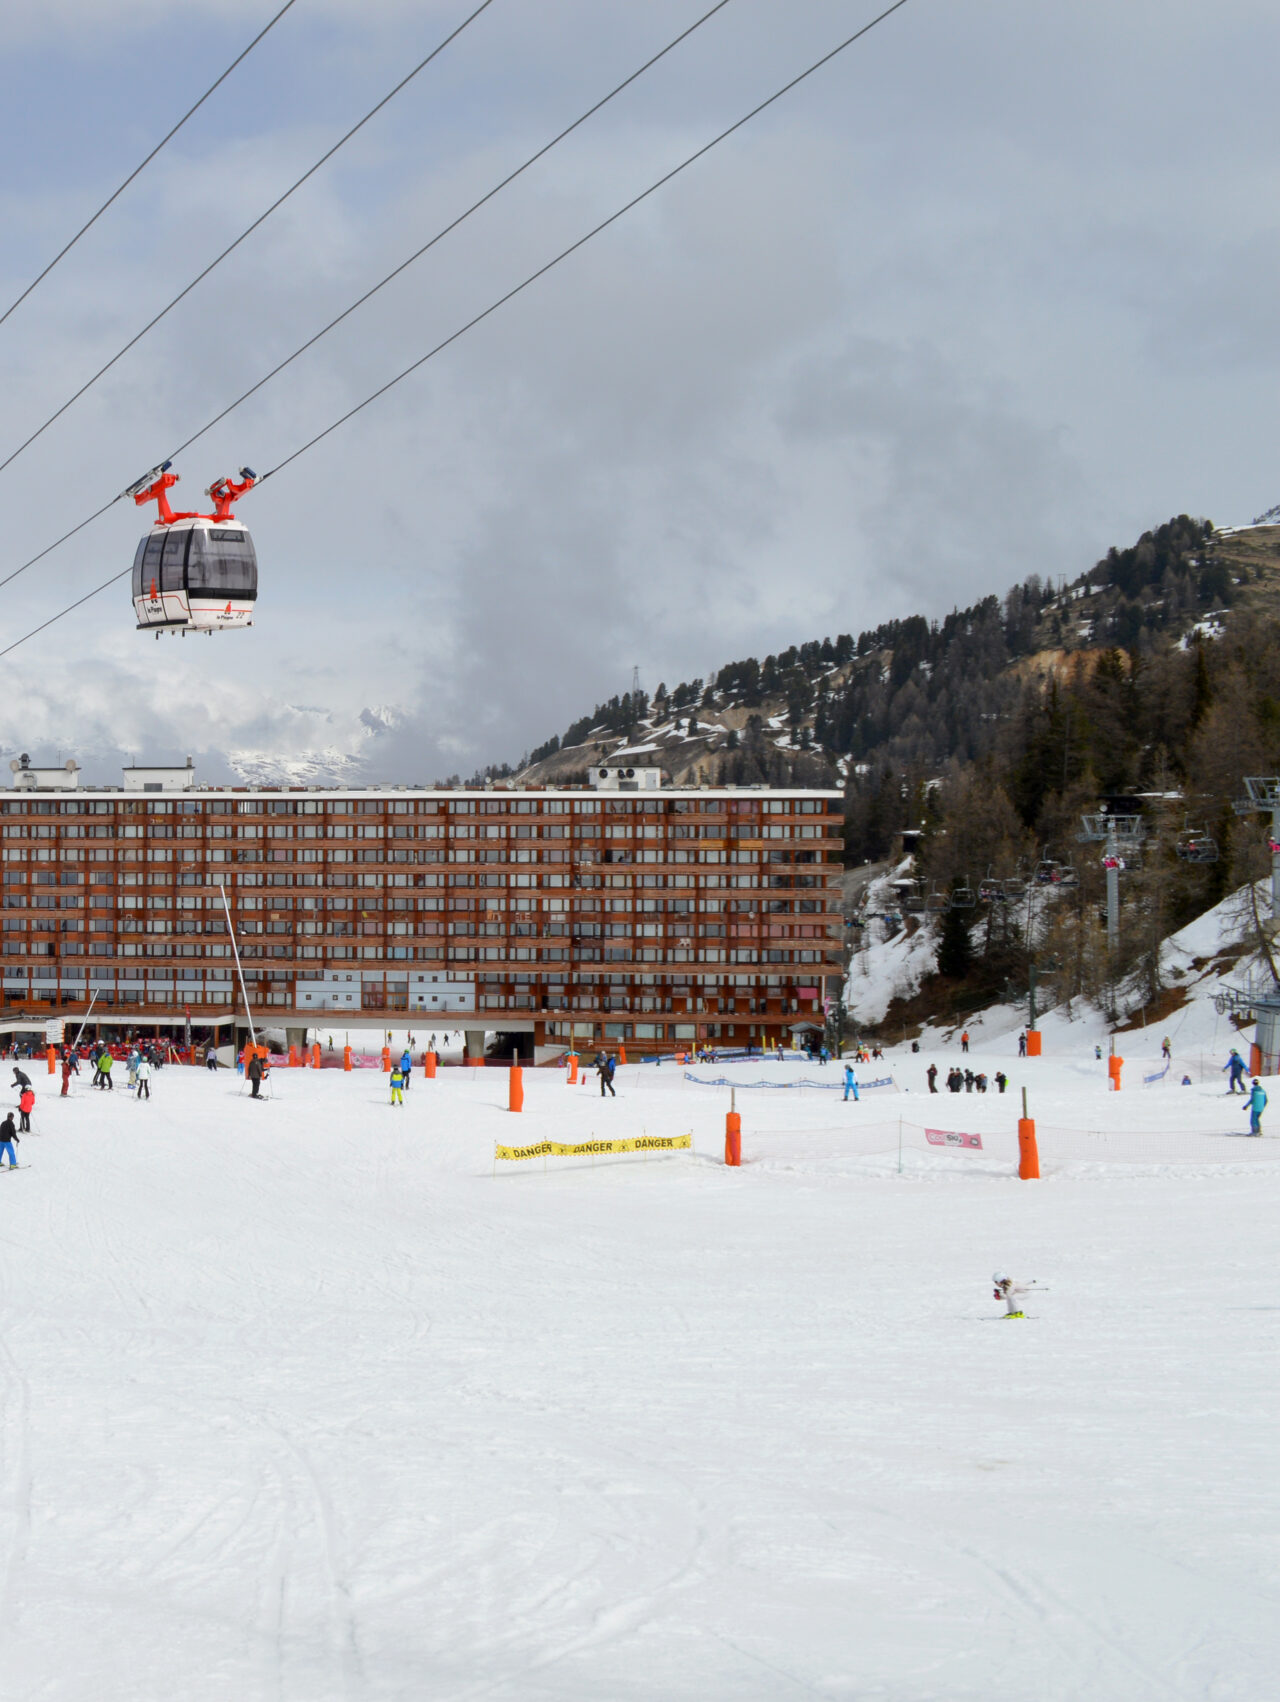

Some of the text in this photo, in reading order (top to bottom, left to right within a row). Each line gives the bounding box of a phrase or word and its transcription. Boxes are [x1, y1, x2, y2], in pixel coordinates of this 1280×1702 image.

[513, 1137, 674, 1158] DANGER DANGER DANGER
